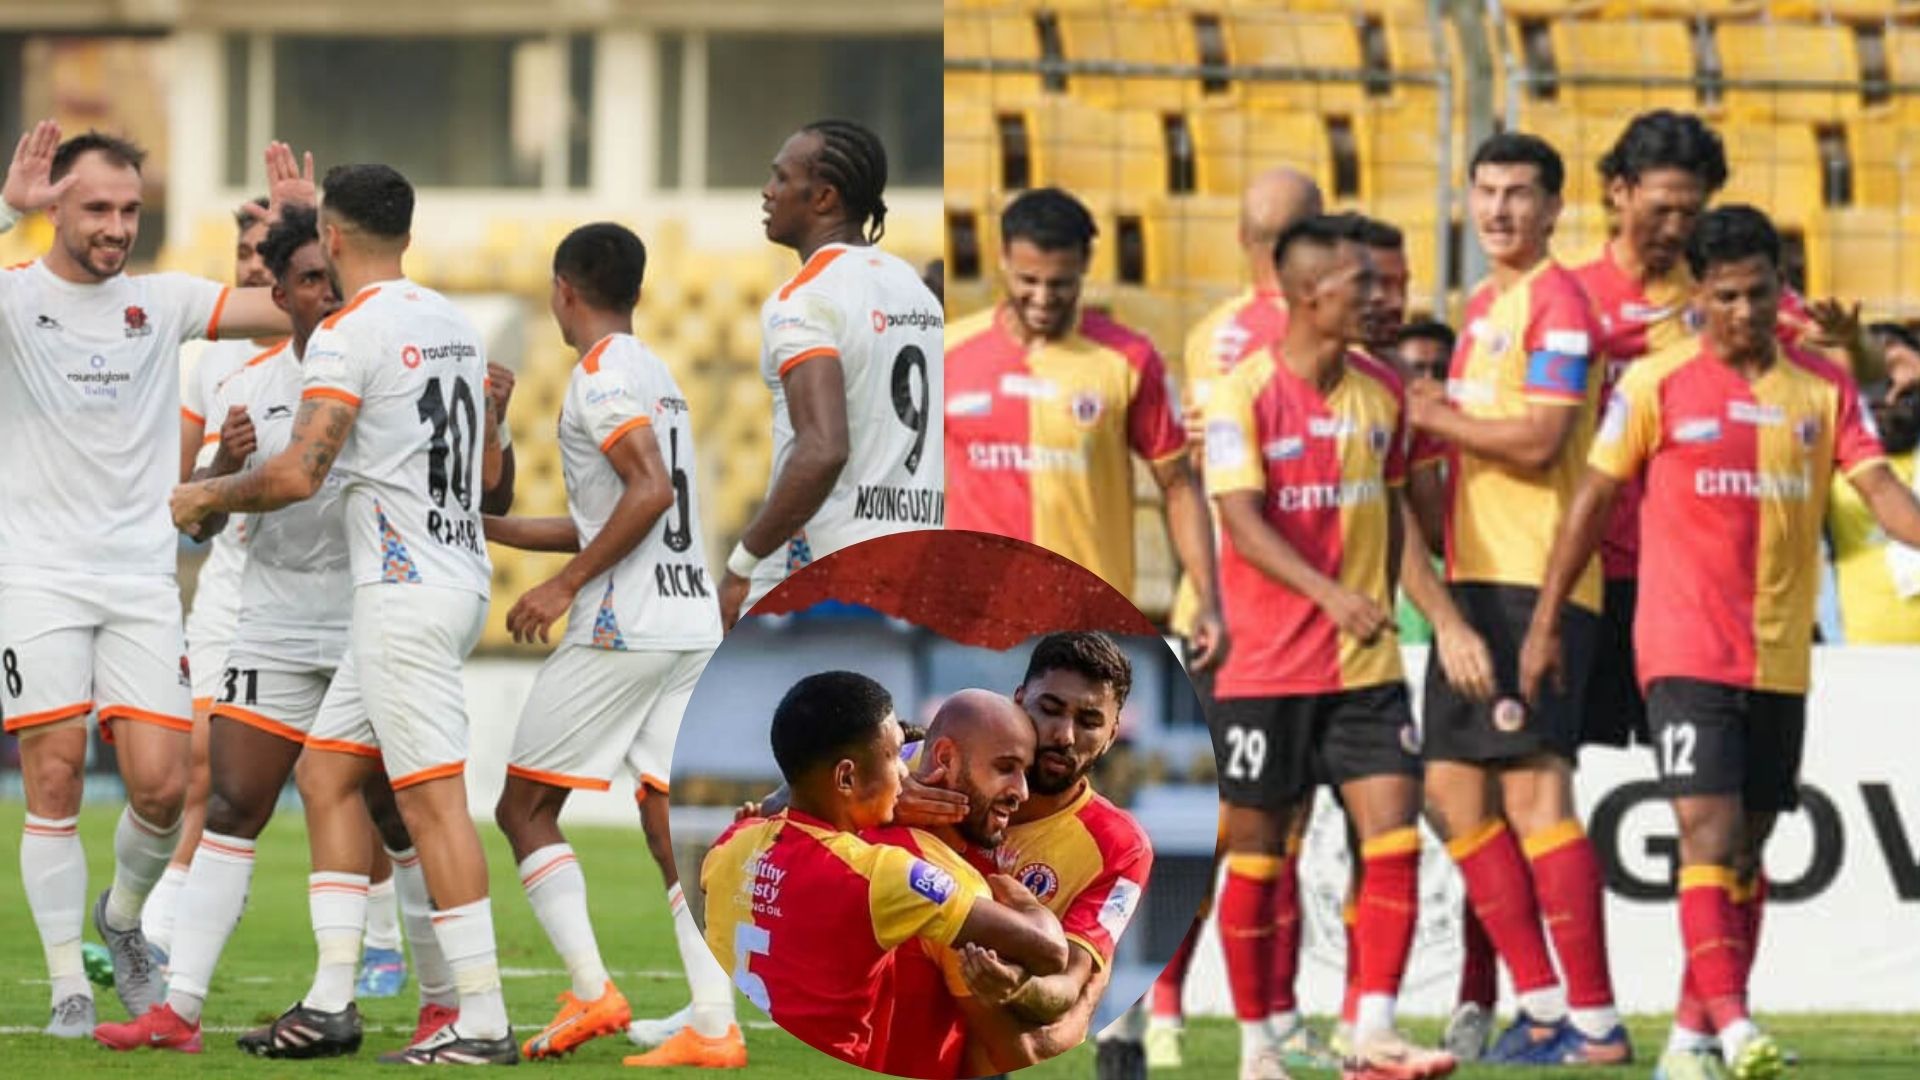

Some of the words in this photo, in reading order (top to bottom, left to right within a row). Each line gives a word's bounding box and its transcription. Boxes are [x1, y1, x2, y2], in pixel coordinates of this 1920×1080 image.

[84, 384, 117, 399] living
[890, 344, 929, 476] 9
[416, 375, 477, 511] 10
[854, 485, 932, 524] NSUNGUSI
[655, 563, 710, 598] RICK
[2, 646, 23, 699] 8
[217, 666, 259, 705] 31
[1225, 725, 1267, 780] 29
[1660, 722, 1697, 776] 12
[733, 921, 771, 1014] 5
